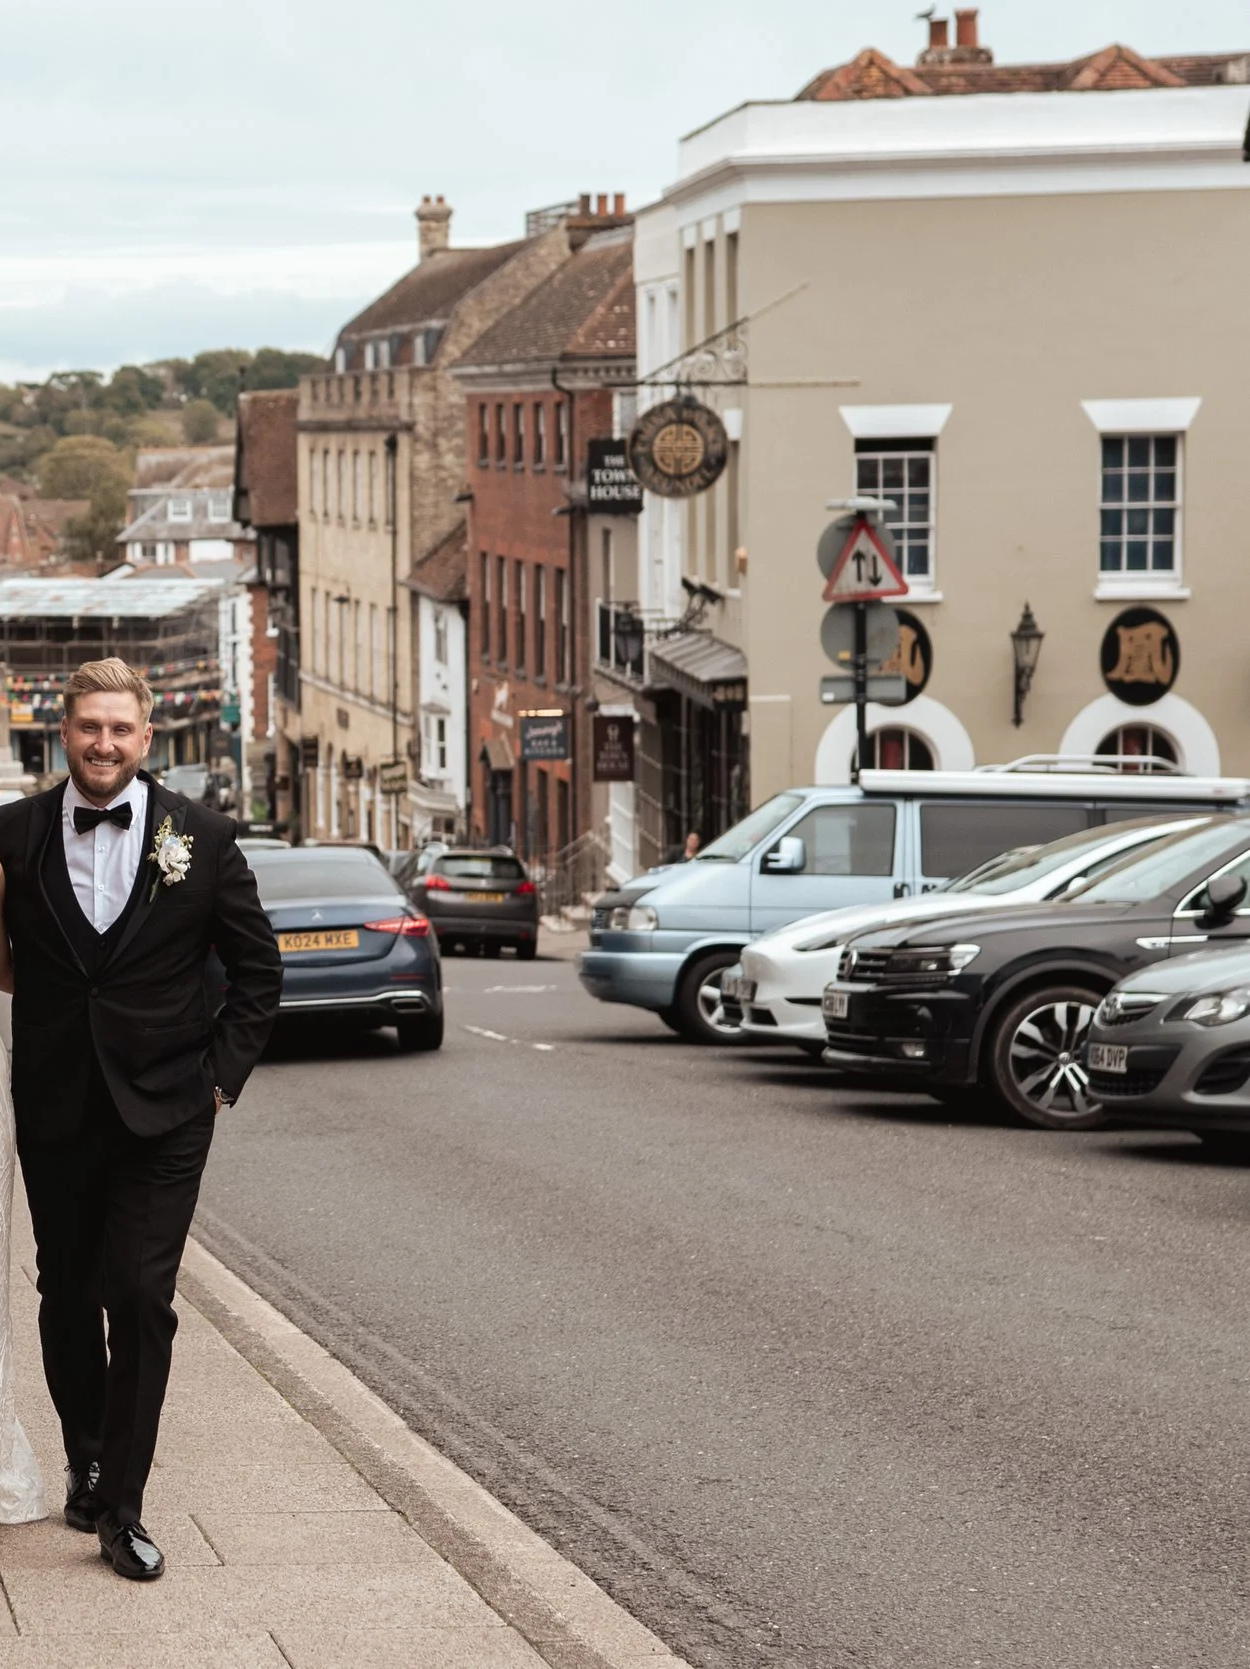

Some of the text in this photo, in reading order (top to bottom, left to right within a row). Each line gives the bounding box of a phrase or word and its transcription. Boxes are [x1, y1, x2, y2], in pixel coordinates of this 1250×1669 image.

[604, 455, 626, 467] THE
[591, 469, 637, 483] TOWN
[590, 485, 640, 500] HOUSE
